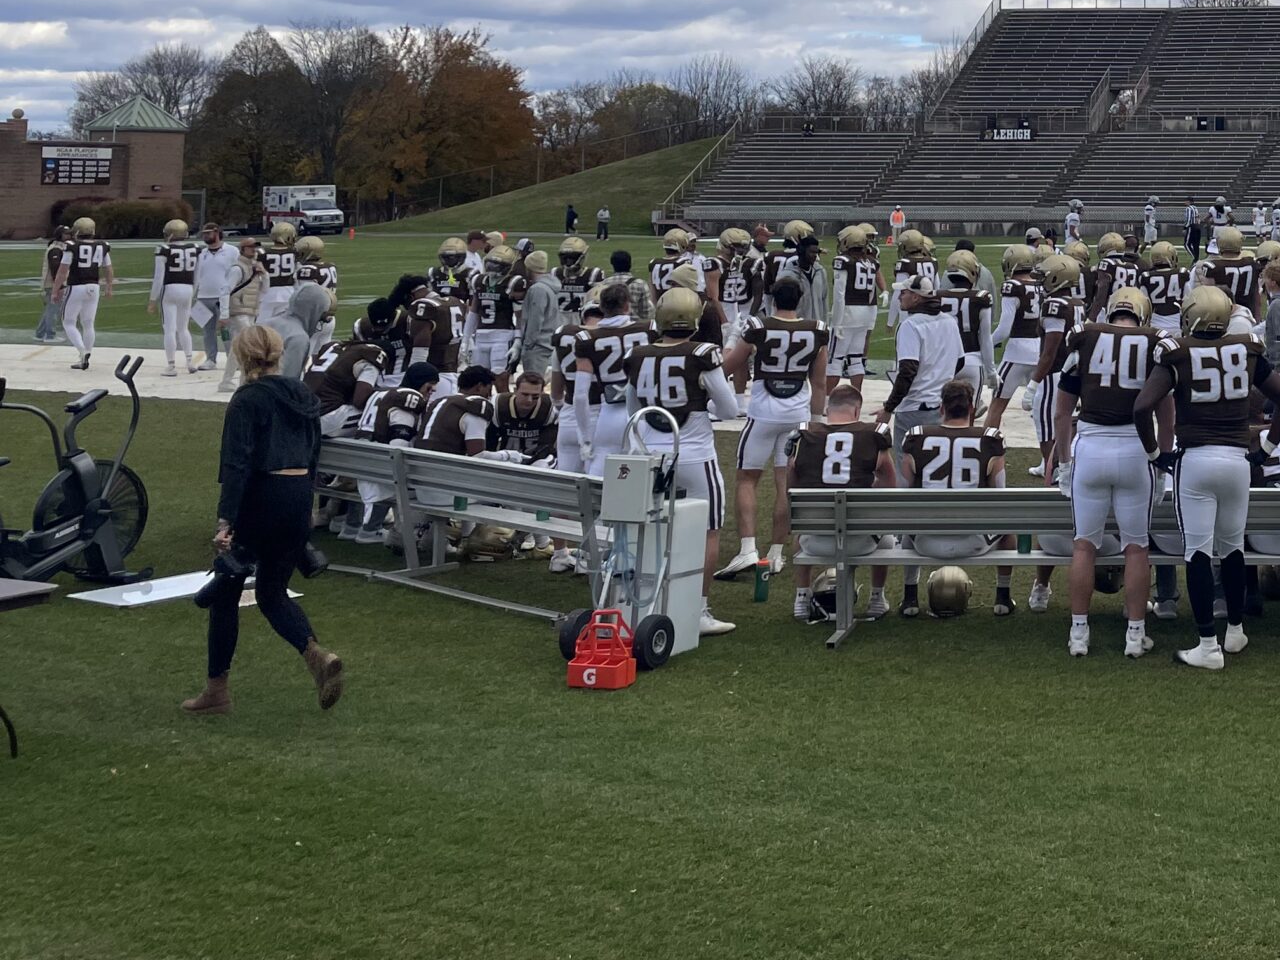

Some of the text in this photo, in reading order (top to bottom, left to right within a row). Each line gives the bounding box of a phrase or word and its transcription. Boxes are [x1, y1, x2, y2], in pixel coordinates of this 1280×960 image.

[993, 128, 1031, 140] LEHIGH
[77, 244, 104, 268] 94
[168, 247, 197, 272] 36
[266, 253, 296, 278] 39
[1001, 282, 1013, 294] 33
[1112, 266, 1137, 293] 83
[1149, 273, 1182, 304] 24
[1224, 264, 1253, 297] 77
[481, 300, 497, 325] 3
[1047, 301, 1061, 315] 15
[760, 329, 815, 373] 32
[1088, 331, 1149, 390] 40
[636, 355, 689, 409] 46
[1188, 342, 1250, 404] 58
[403, 393, 420, 410] 16
[480, 400, 487, 415] 1
[422, 398, 448, 440] 1
[505, 428, 540, 438] LEHIGH
[821, 431, 854, 485] 8
[921, 436, 982, 489] 26
[582, 668, 597, 685] G
